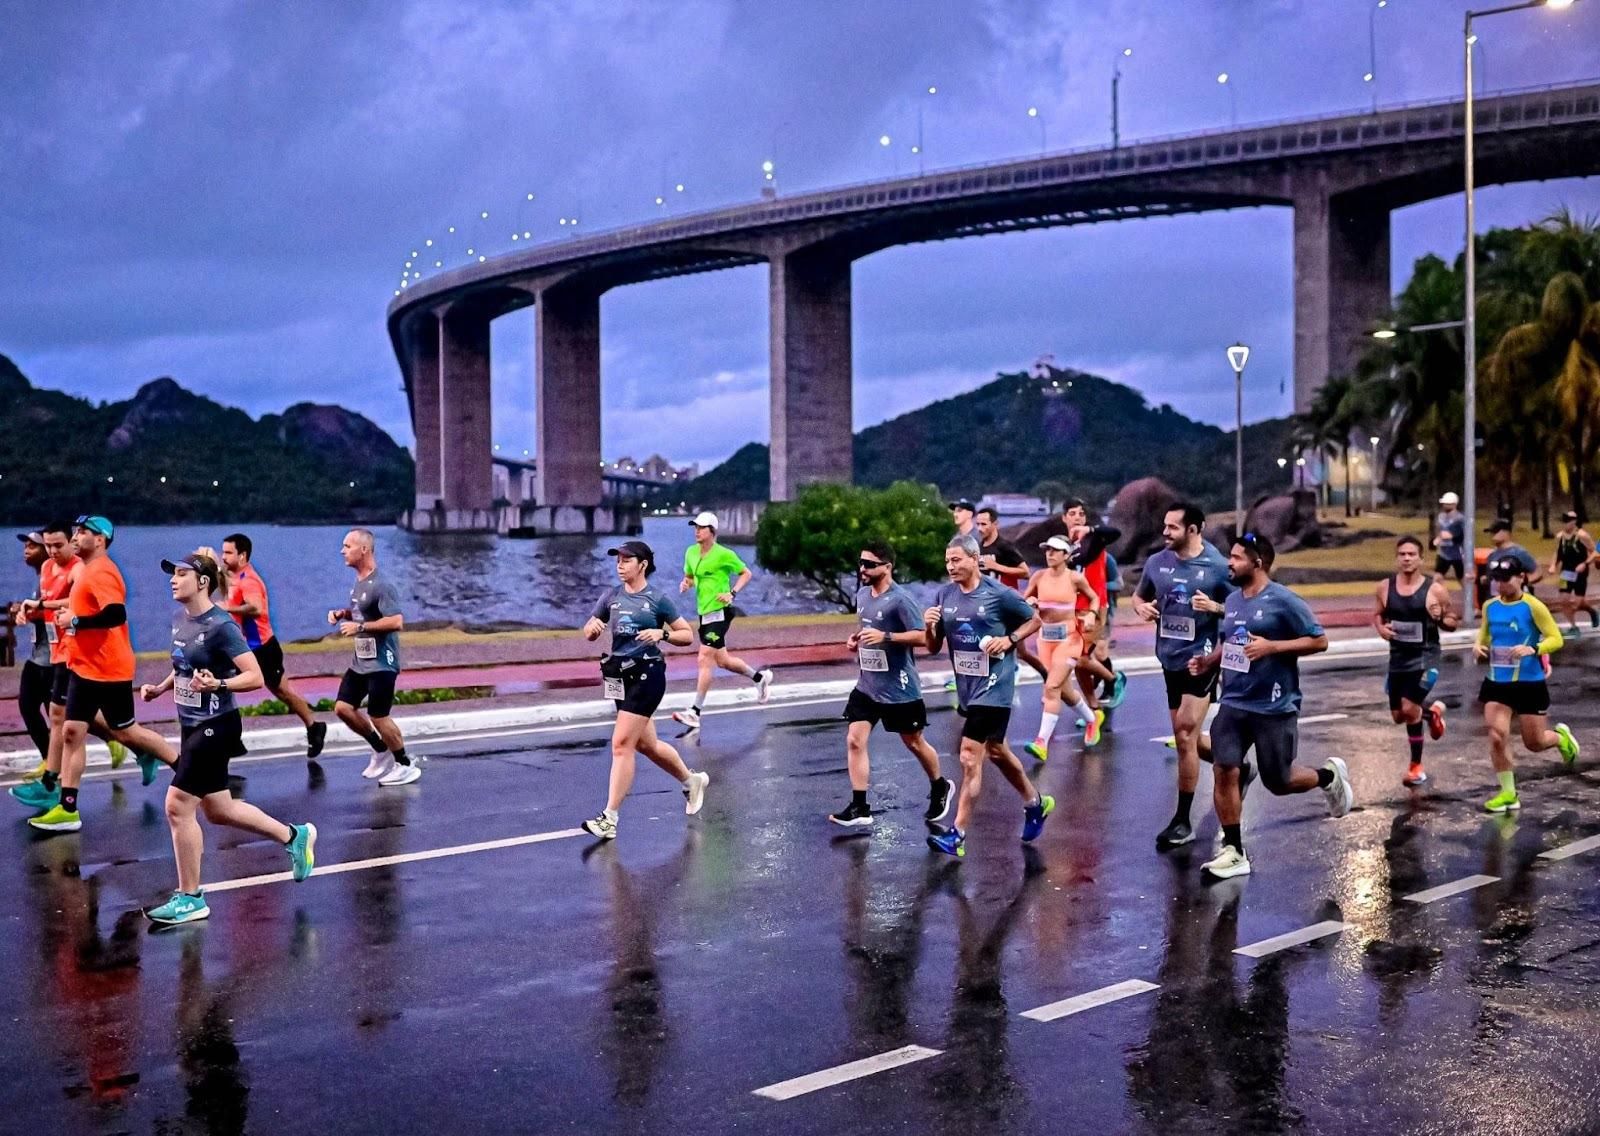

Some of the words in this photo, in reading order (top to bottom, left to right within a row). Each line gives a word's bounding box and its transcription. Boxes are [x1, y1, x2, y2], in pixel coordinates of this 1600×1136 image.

[1163, 623, 1190, 633] 4600
[959, 660, 980, 670] 4123
[175, 902, 195, 914] FILA
